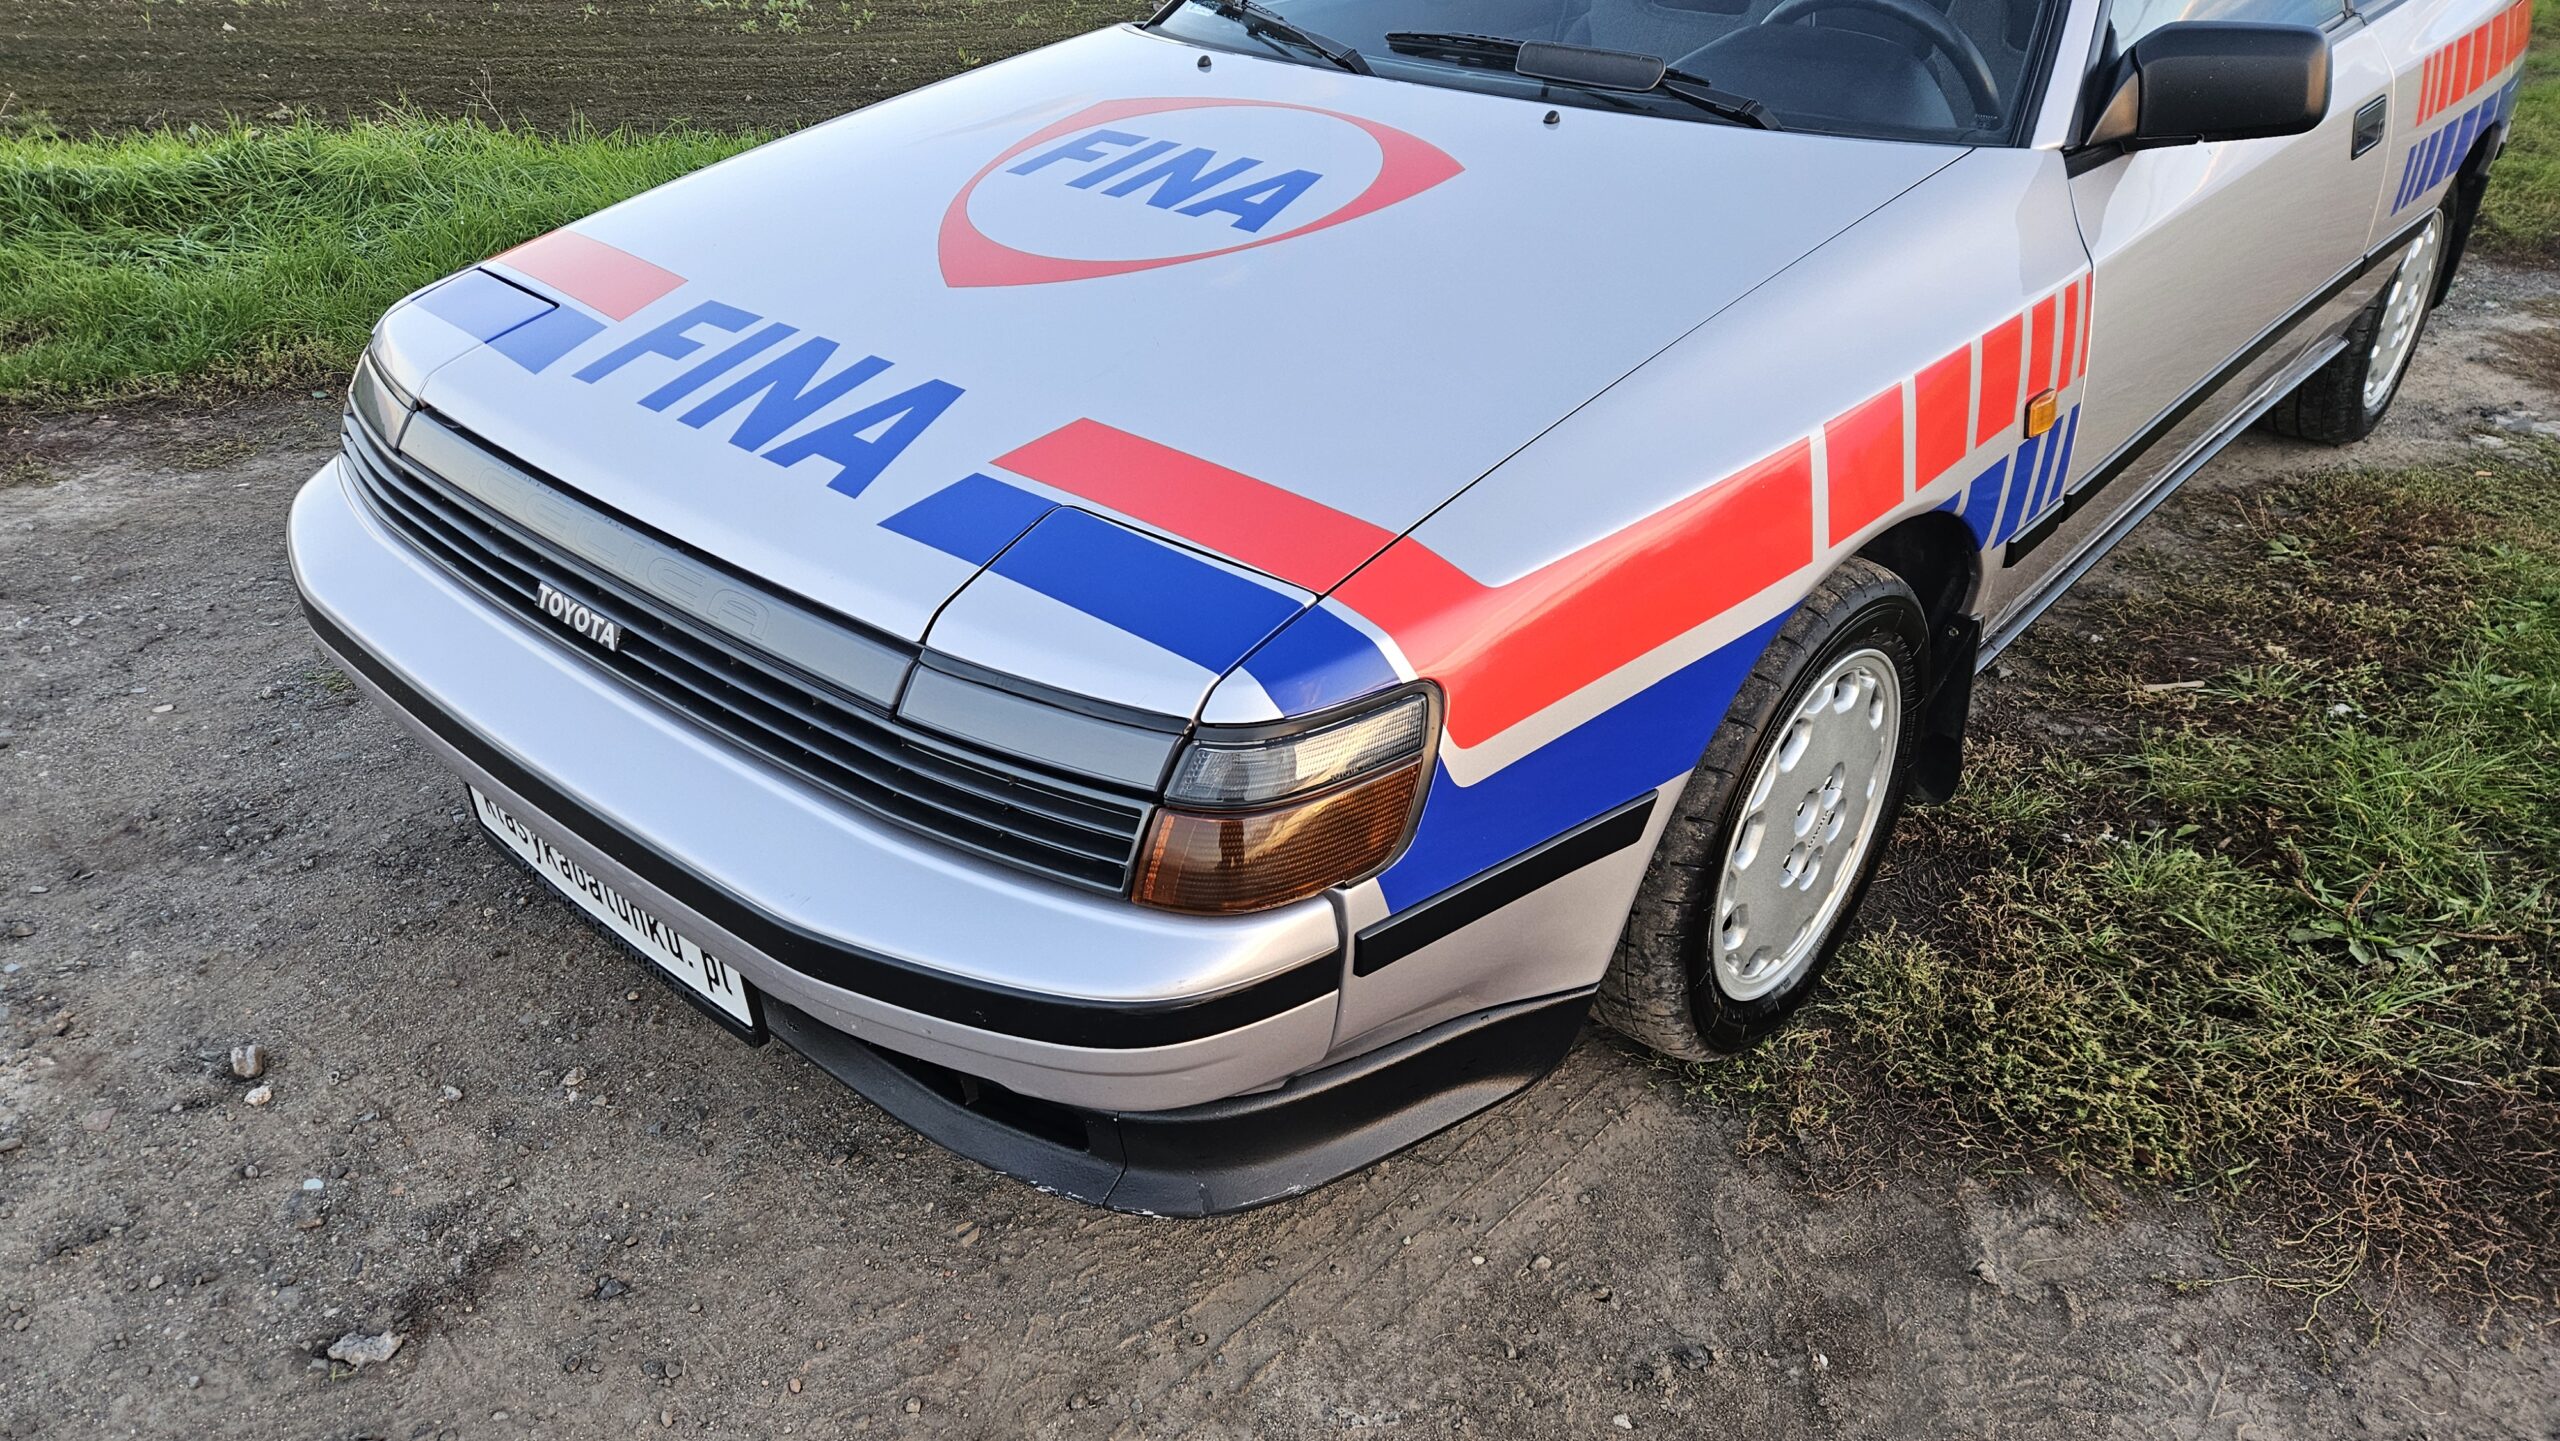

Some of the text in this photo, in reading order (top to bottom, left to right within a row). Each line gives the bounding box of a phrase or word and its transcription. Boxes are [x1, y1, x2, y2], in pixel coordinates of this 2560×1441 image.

[1005, 129, 1324, 234] FINA
[571, 299, 967, 500] FINA
[538, 581, 617, 652] TOYOTA
